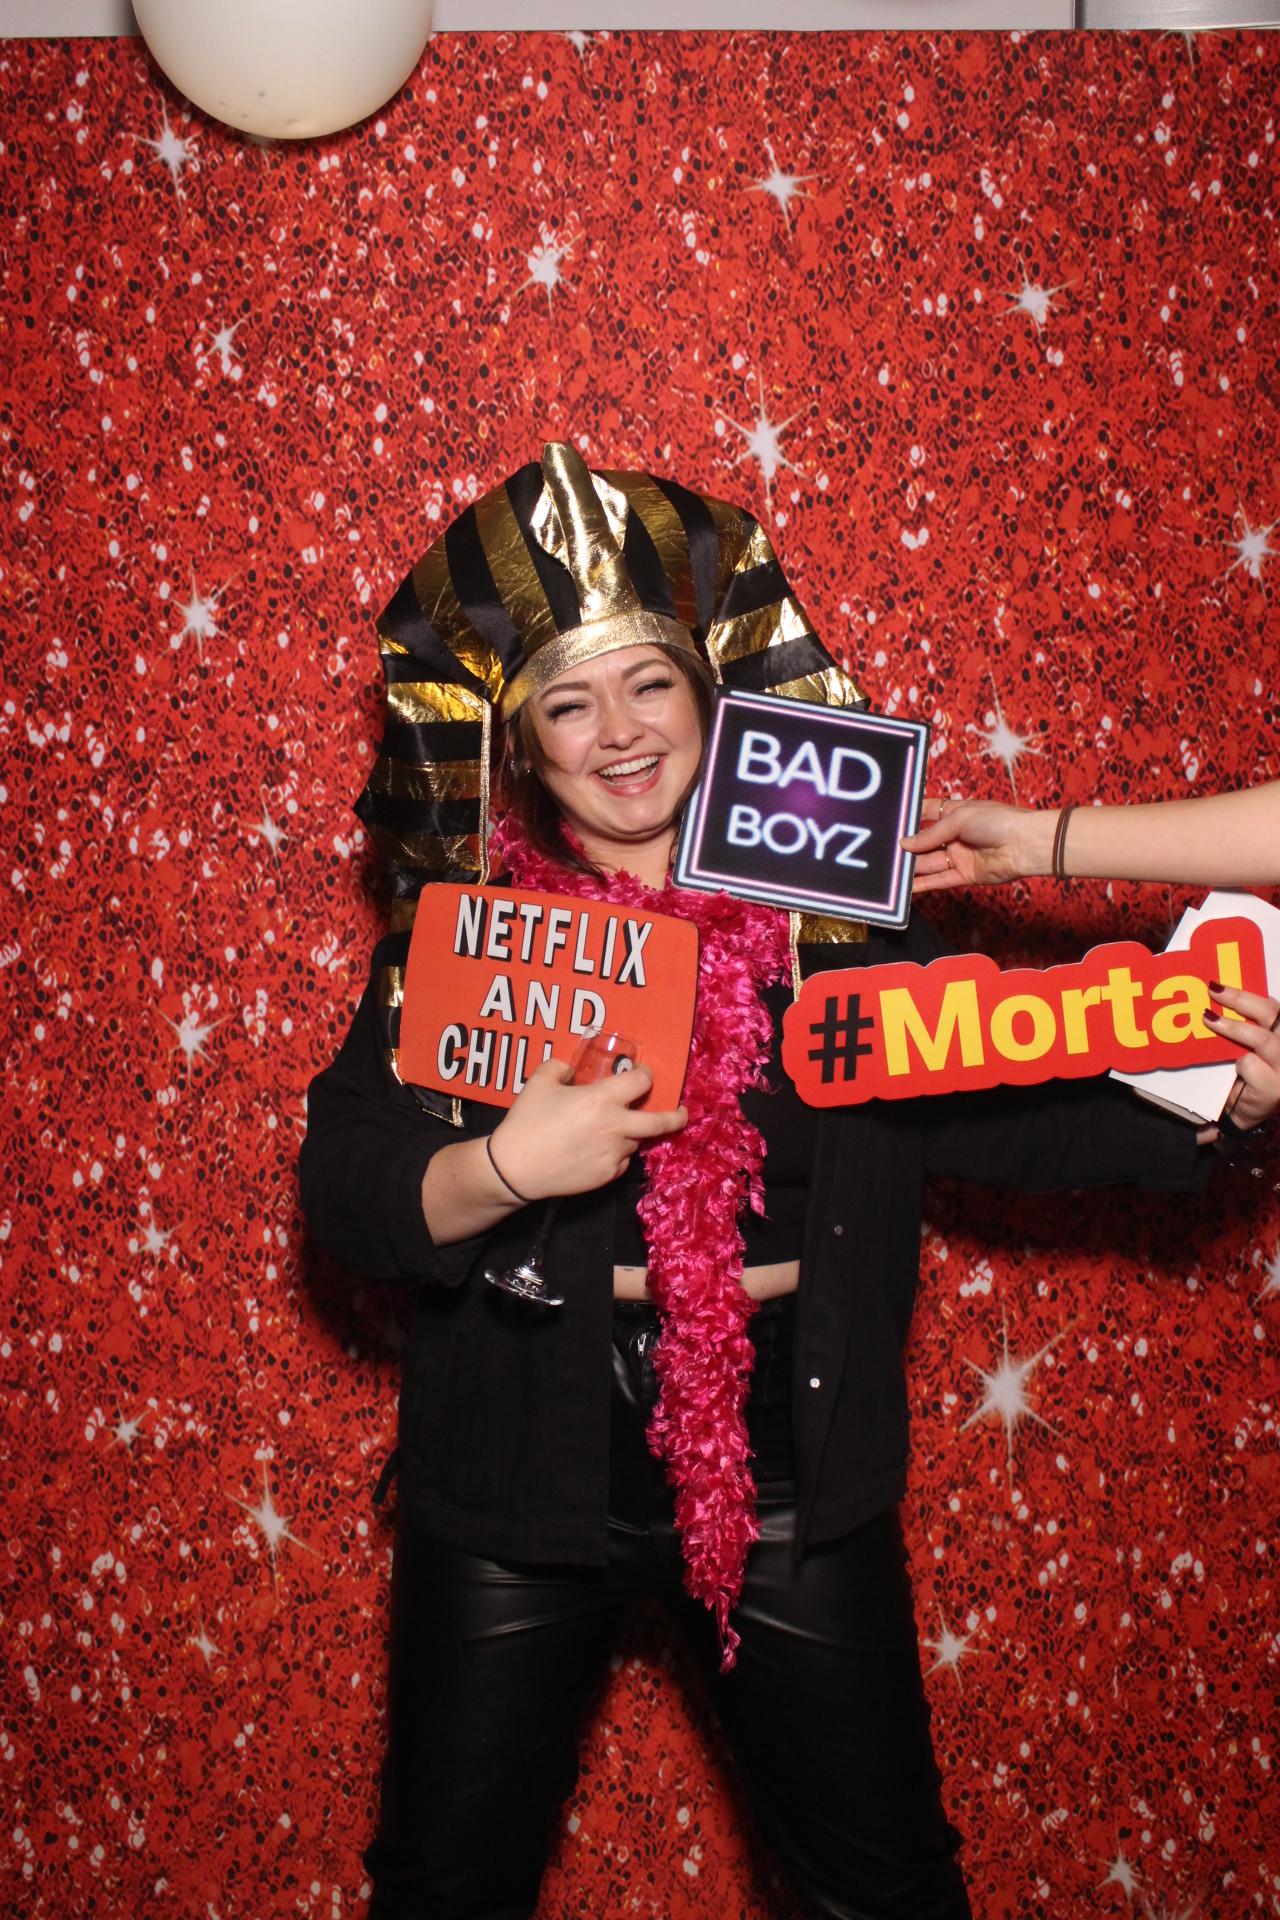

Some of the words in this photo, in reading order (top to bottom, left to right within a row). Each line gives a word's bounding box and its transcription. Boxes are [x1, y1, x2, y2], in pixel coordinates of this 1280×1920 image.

[737, 730, 881, 801] BAD
[726, 803, 872, 869] BOYZ
[453, 893, 653, 987] NETFLIX
[480, 974, 607, 1038] AND
[808, 941, 1245, 1084] #Mortal
